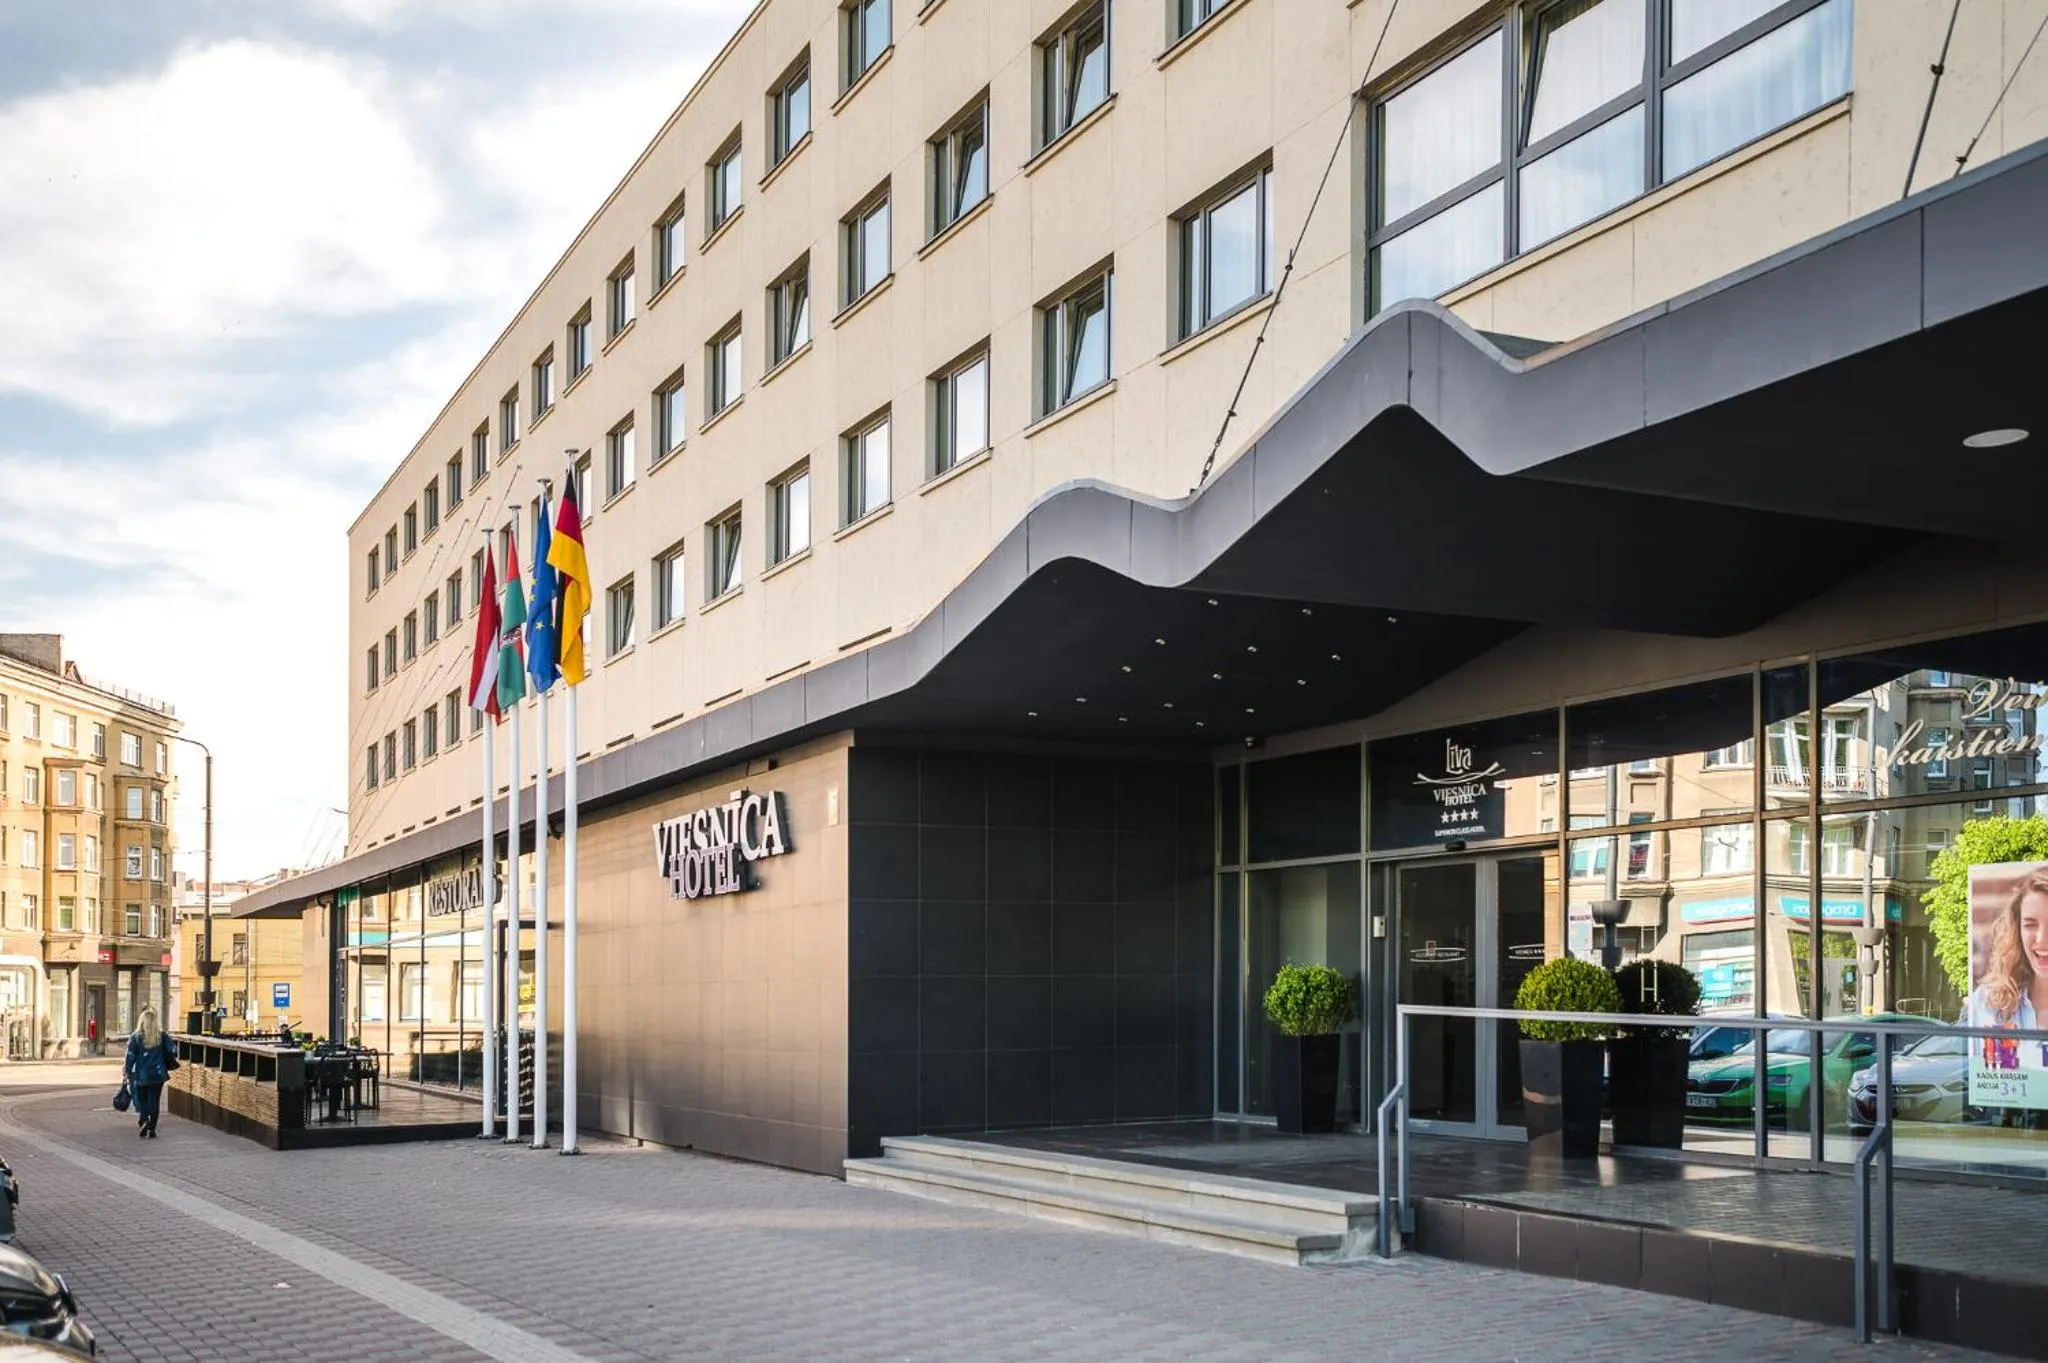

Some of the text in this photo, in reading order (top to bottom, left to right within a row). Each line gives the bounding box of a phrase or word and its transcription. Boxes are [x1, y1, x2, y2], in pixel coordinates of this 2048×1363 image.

[1445, 794, 1475, 807] HOTEL
[652, 790, 784, 877] VIESNĪCA
[669, 843, 741, 899] HOTEL
